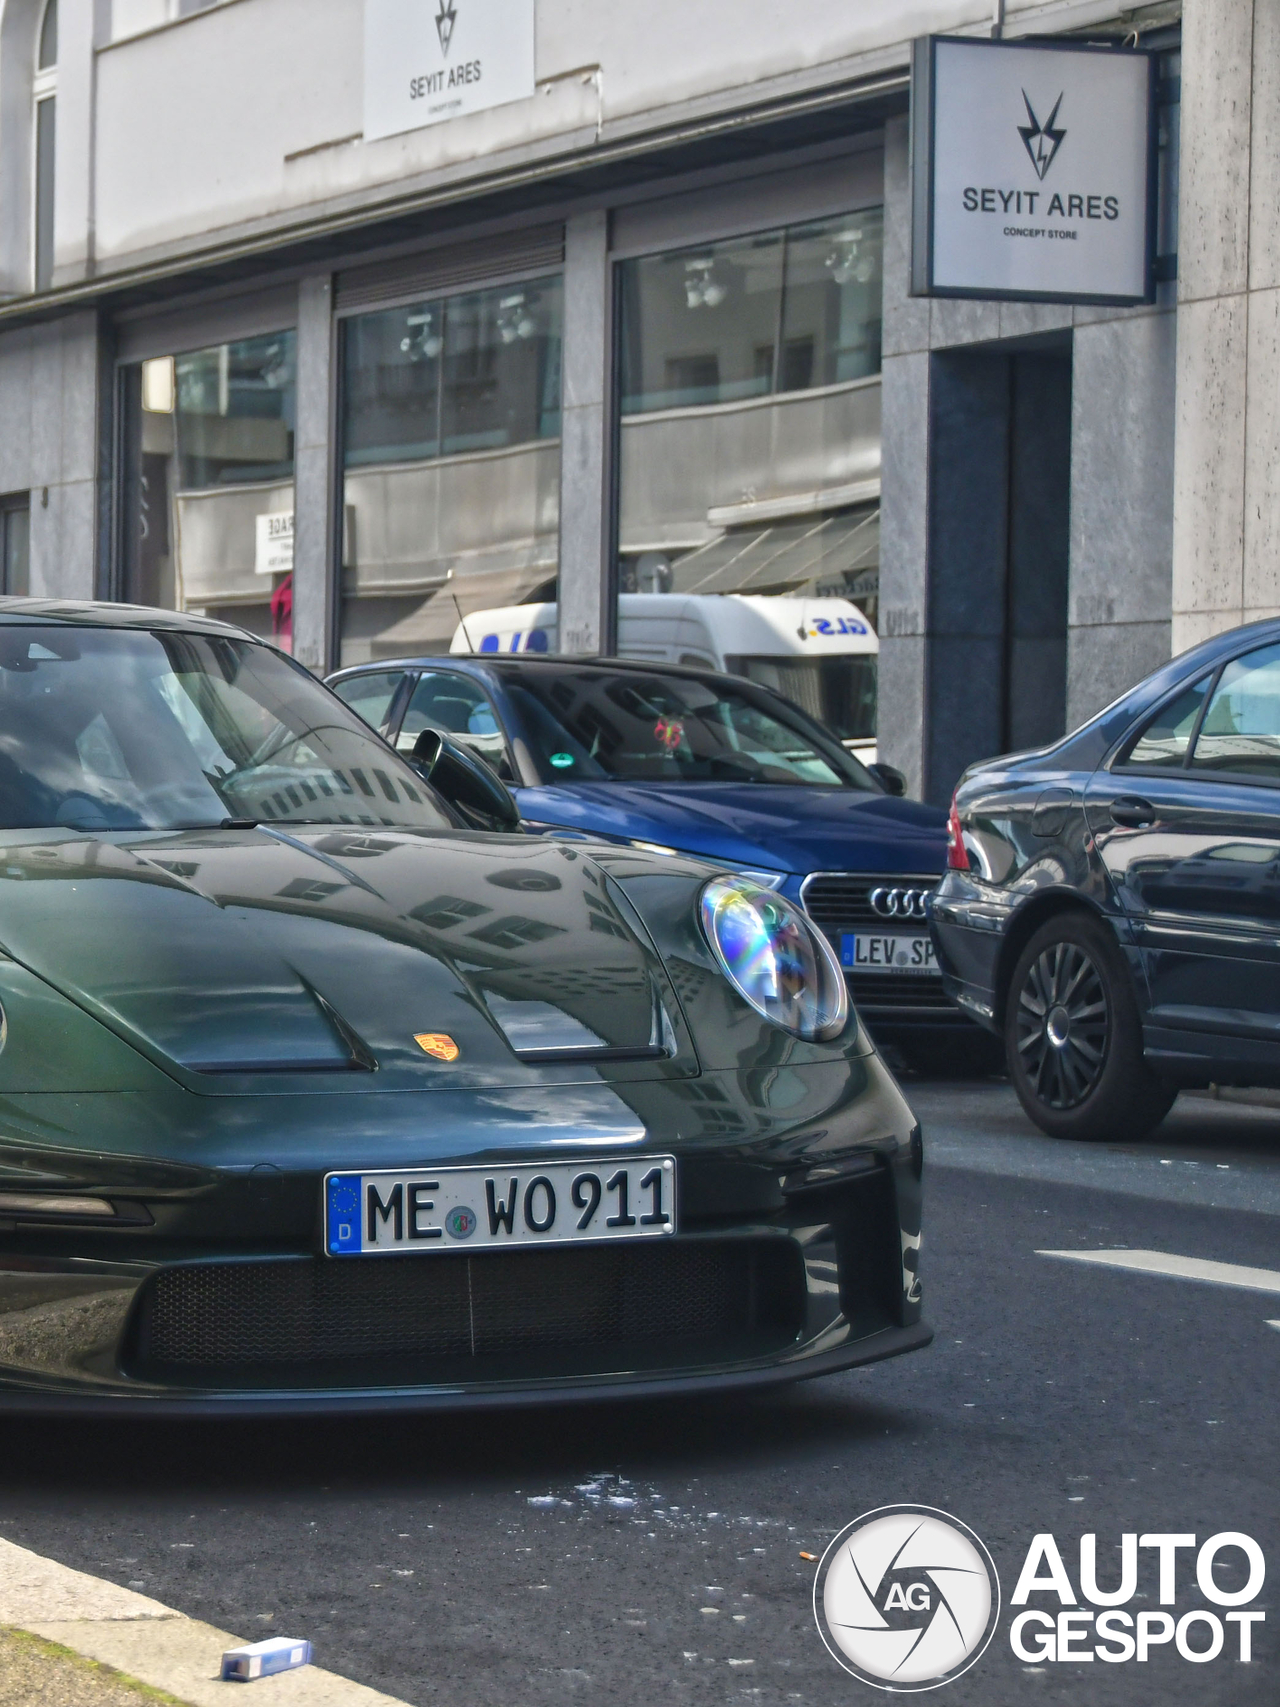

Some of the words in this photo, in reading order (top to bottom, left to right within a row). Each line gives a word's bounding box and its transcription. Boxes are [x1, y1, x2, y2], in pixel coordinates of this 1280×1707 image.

[410, 69, 444, 100] SEYIT
[447, 59, 481, 89] ARES
[962, 186, 1040, 215] SEYIT
[1046, 192, 1119, 221] ARES
[1003, 226, 1045, 238] CONCEPT
[1047, 229, 1078, 240] STORE
[855, 938, 896, 964] LEV
[338, 1223, 351, 1240] D
[366, 1180, 442, 1242] ME
[484, 1174, 557, 1236] WO
[571, 1166, 670, 1230] 911
